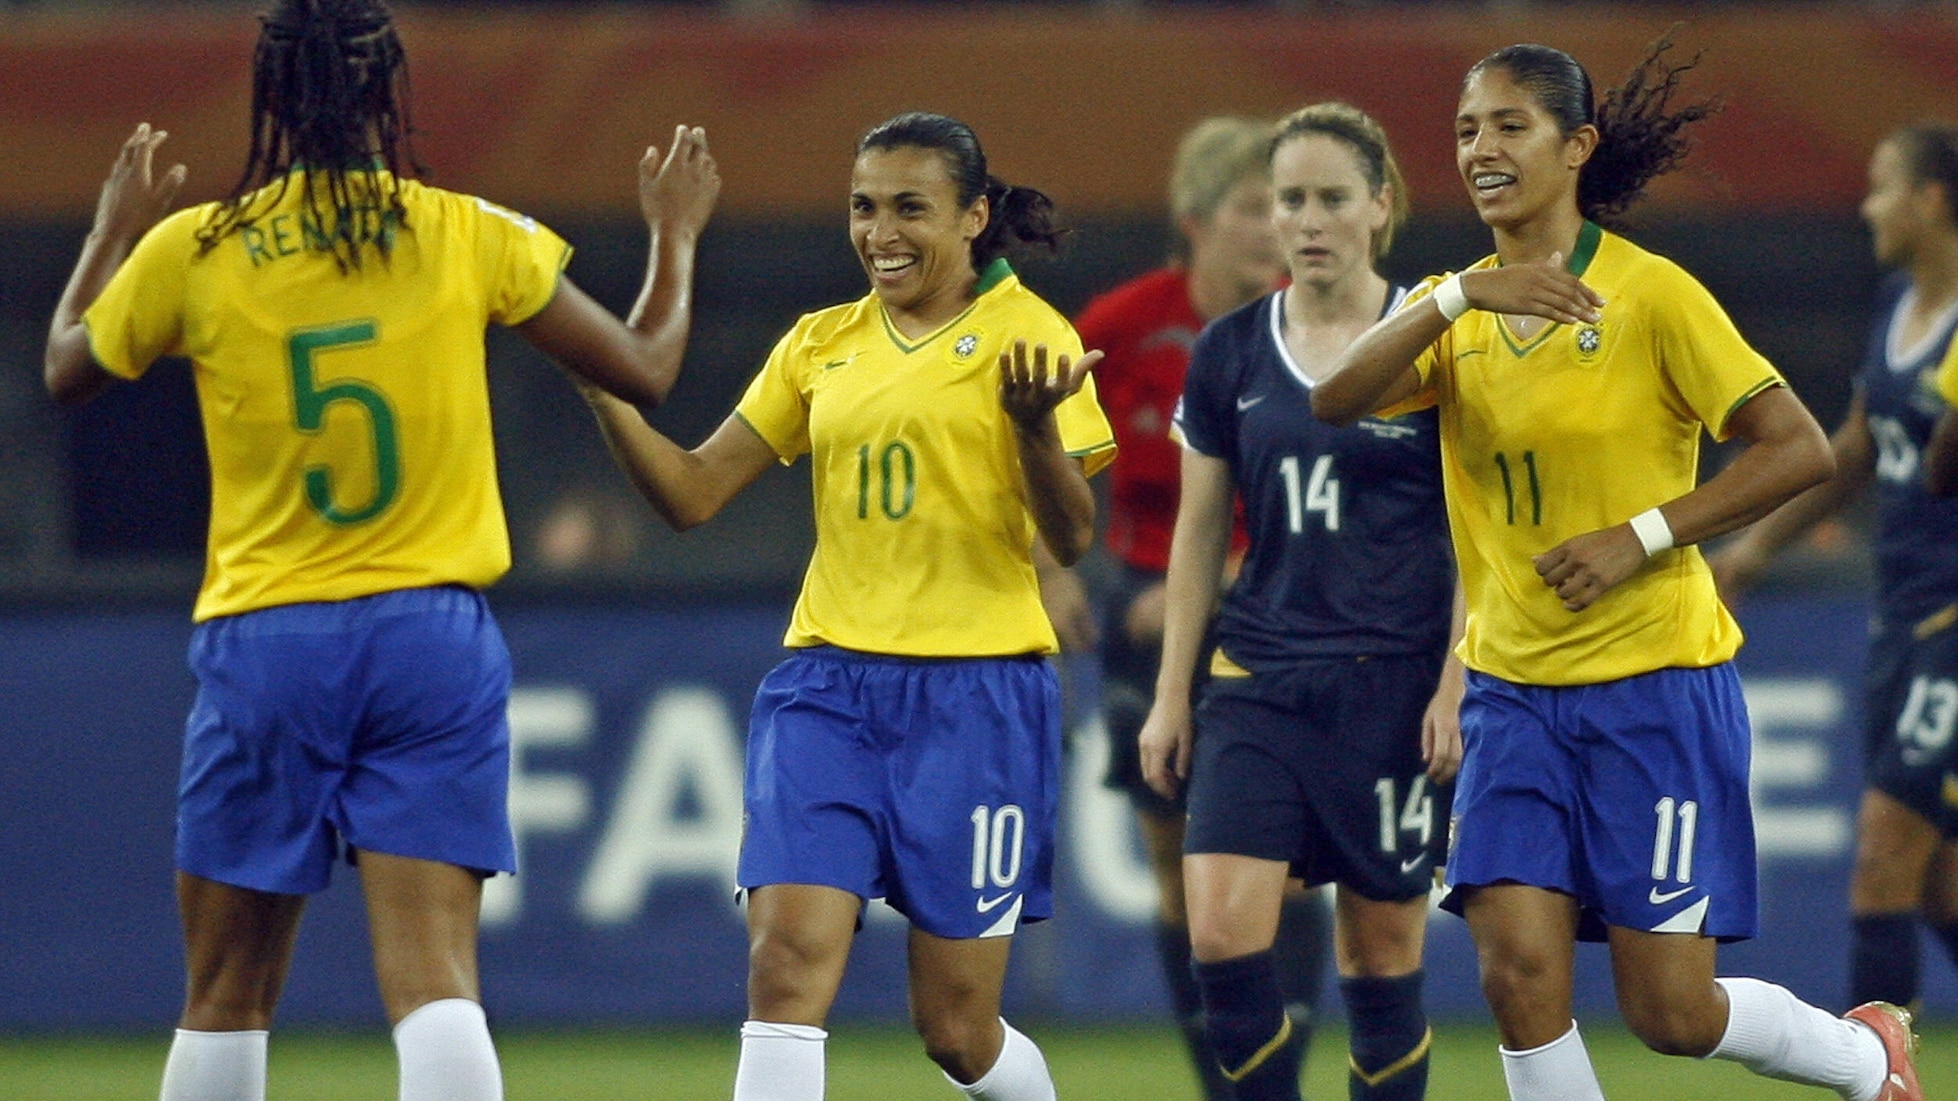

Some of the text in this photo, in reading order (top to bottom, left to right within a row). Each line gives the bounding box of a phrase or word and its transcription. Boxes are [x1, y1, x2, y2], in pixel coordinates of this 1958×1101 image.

[241, 203, 397, 268] RENT
[287, 318, 398, 526] 5
[858, 441, 914, 520] 10
[1279, 454, 1340, 534] 14
[1495, 450, 1541, 526] 11
[1897, 675, 1957, 749] 13
[970, 804, 1024, 889] 10
[1374, 773, 1434, 852] 14
[1651, 796, 1698, 884] 11
